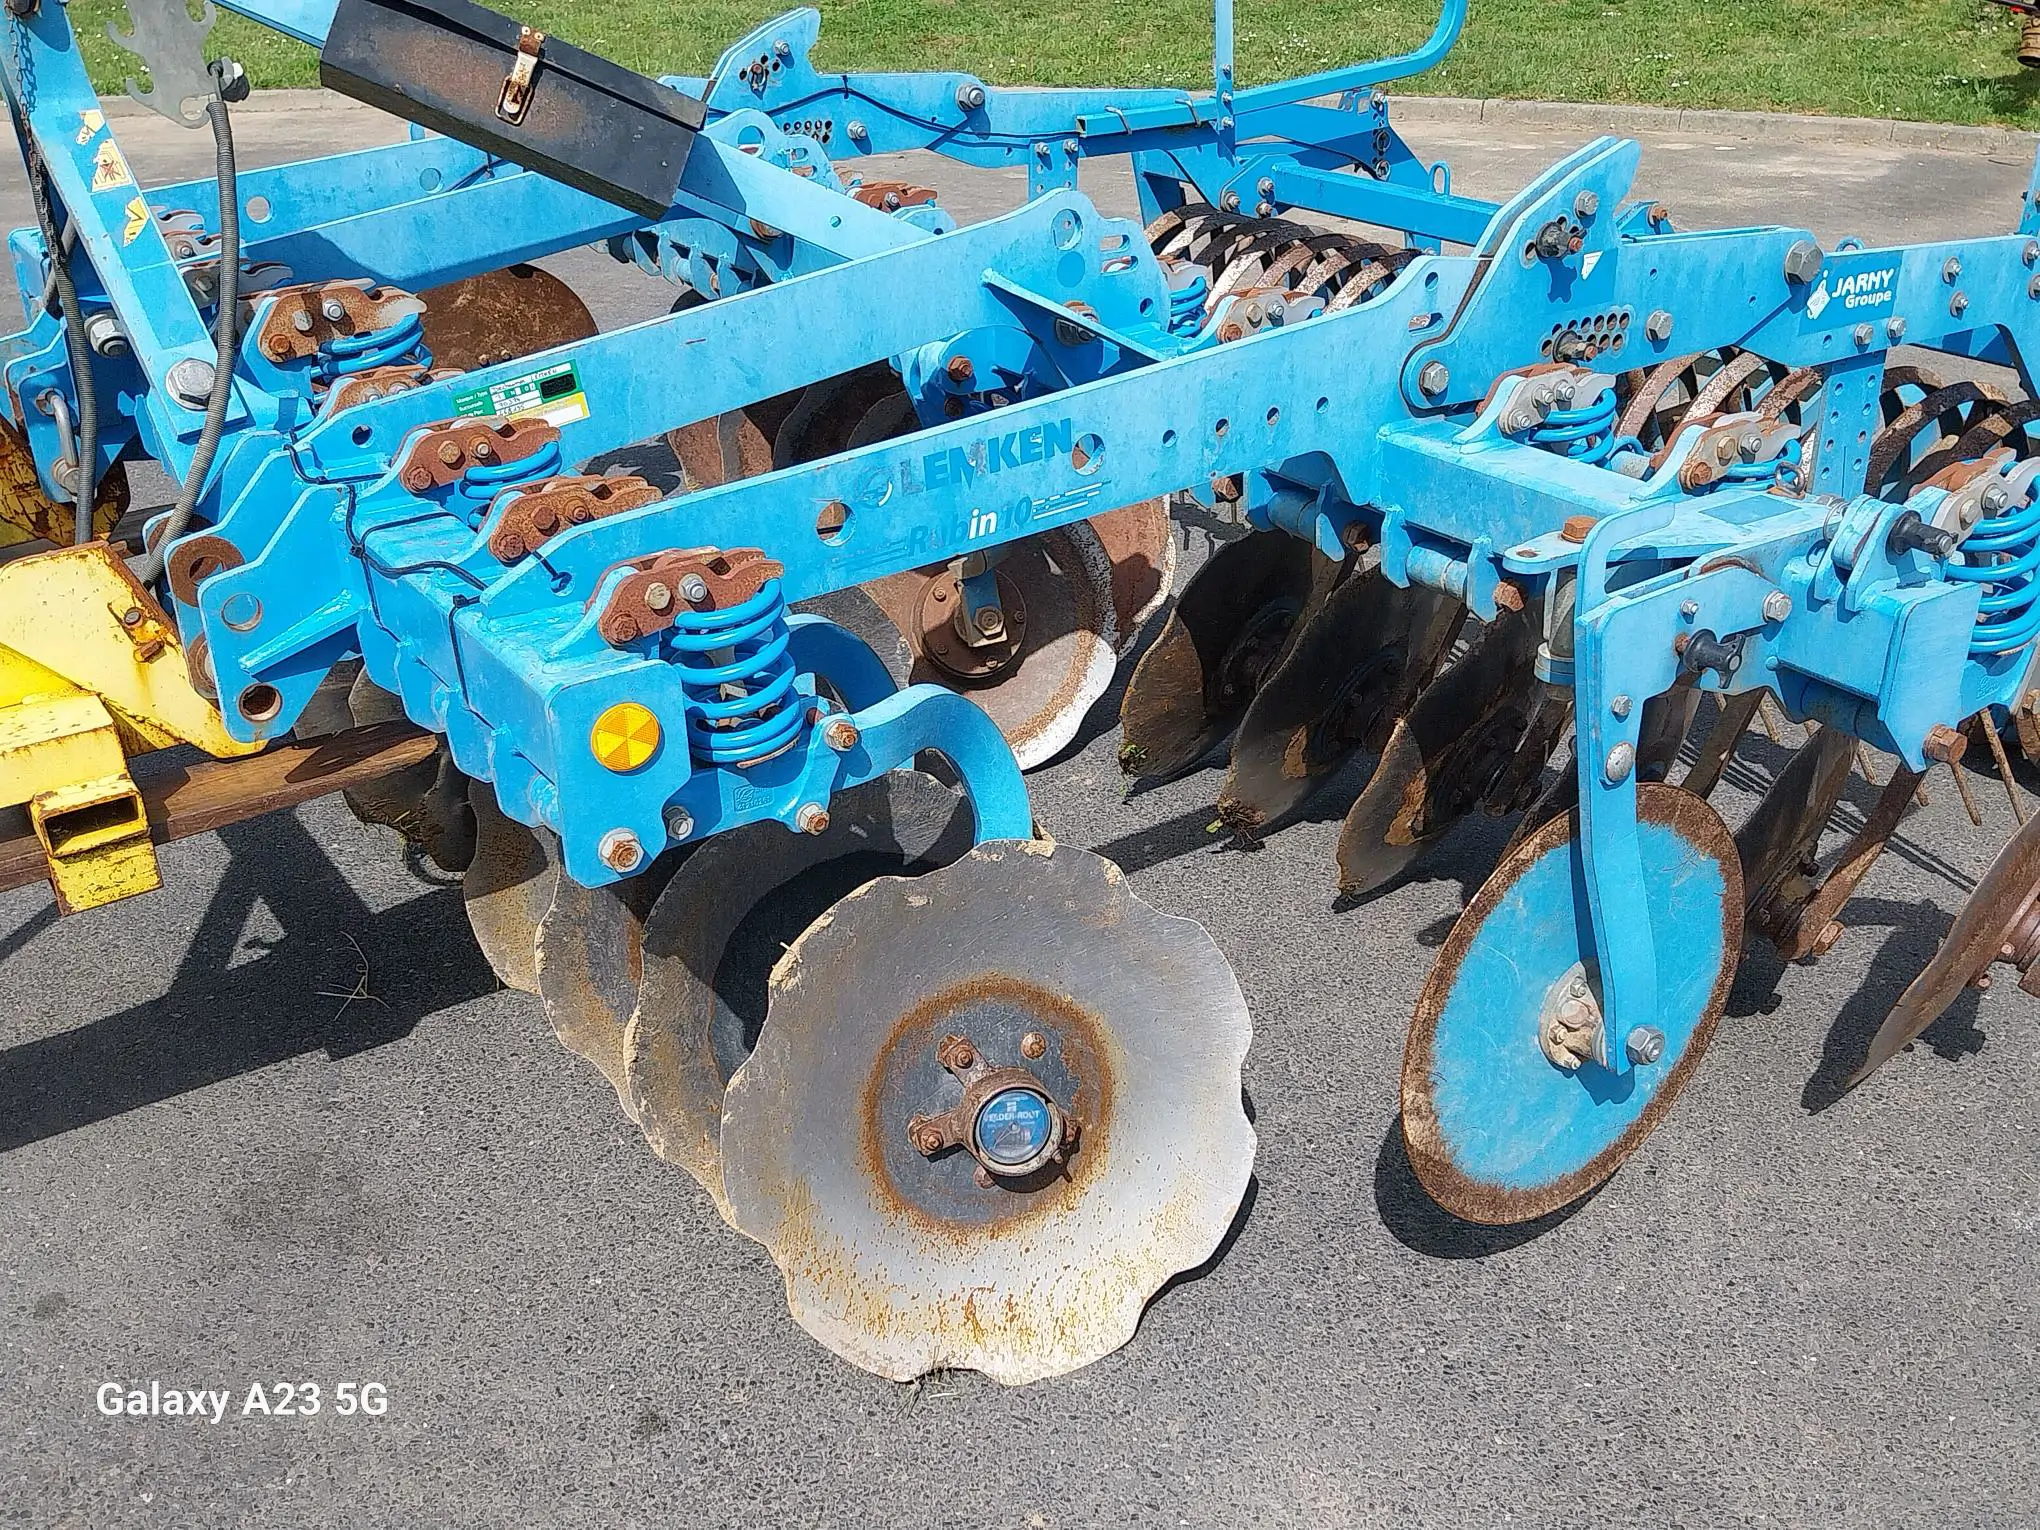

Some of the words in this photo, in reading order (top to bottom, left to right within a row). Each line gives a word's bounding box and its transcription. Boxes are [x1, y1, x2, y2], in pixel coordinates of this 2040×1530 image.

[1832, 268, 1894, 297] JARNY
[1845, 290, 1892, 309] Groupe
[900, 418, 1073, 496] LEMKEN
